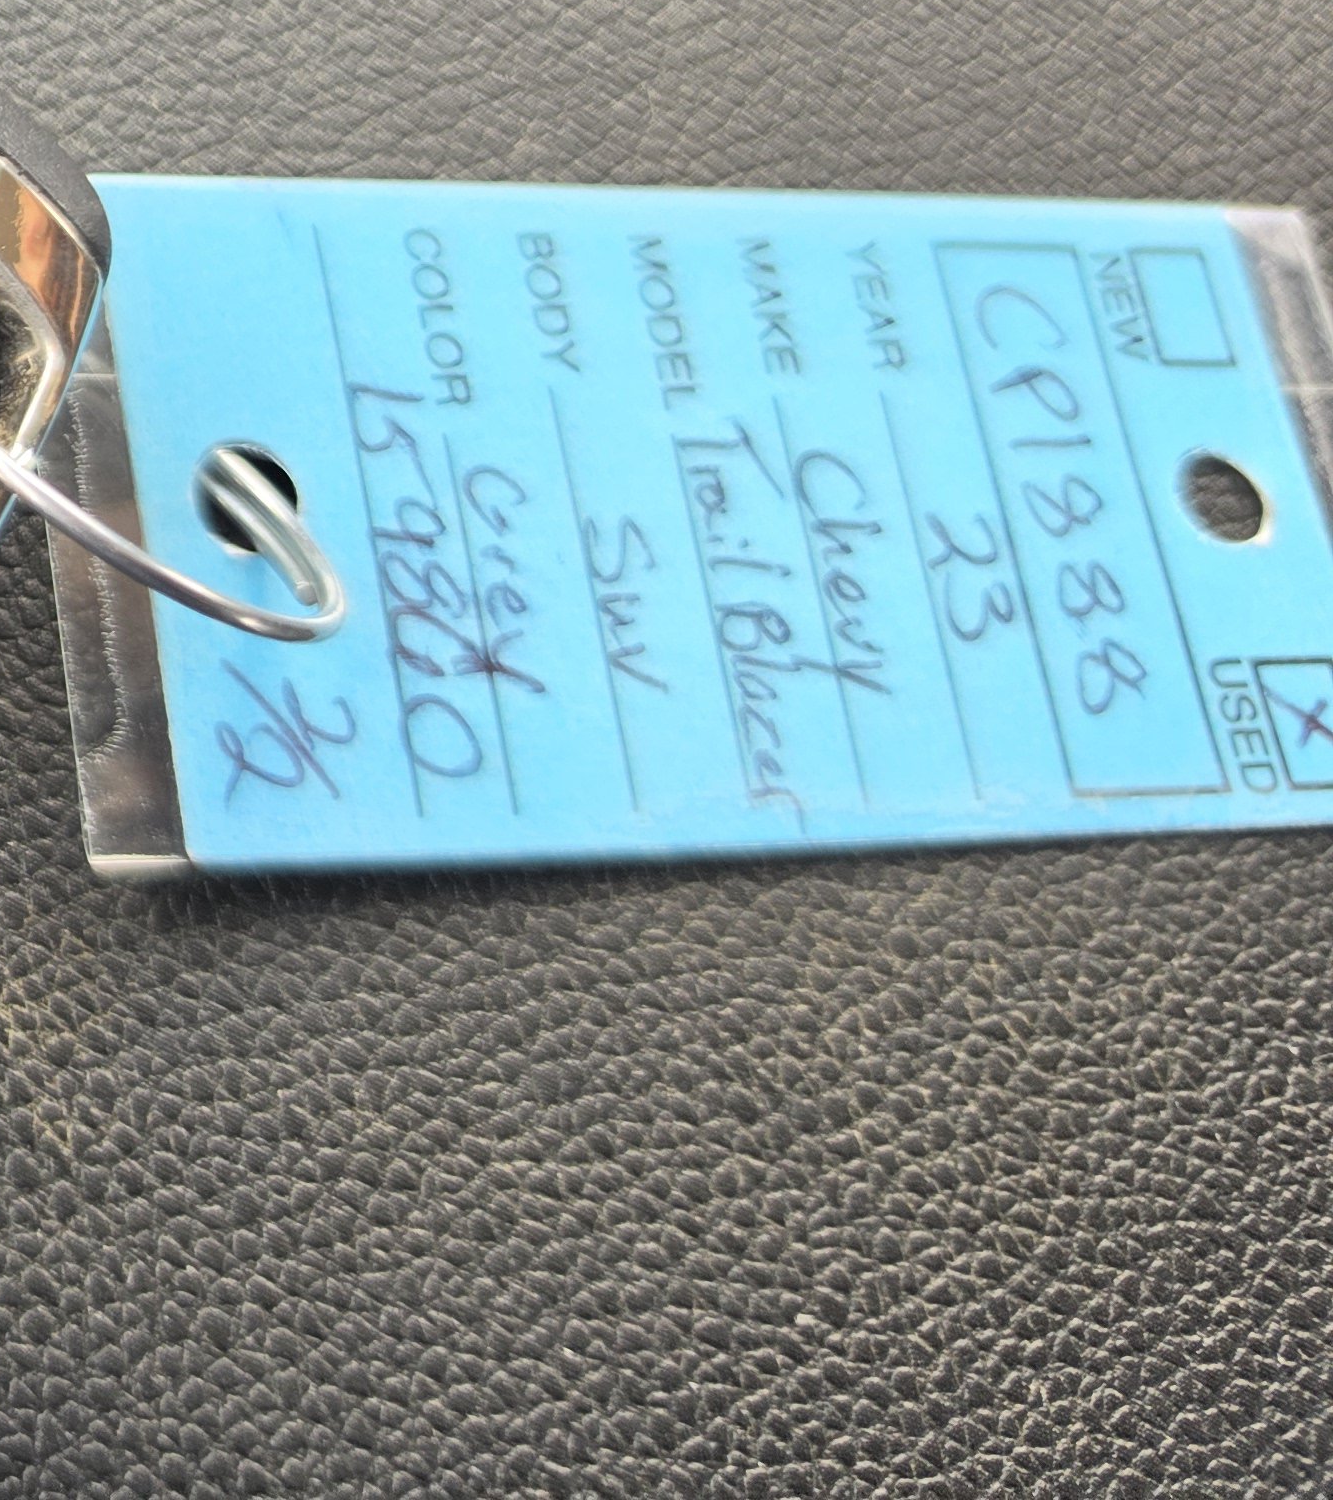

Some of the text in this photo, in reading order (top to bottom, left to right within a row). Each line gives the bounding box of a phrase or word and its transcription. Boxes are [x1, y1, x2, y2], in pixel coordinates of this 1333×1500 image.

[403, 227, 472, 408] COLOR
[517, 230, 581, 375] BODY
[629, 234, 701, 410] MODEL
[738, 235, 803, 378] MAKE
[845, 240, 908, 375] YEAR
[1089, 251, 1149, 362] NEW
[453, 463, 546, 695] Grey
[789, 448, 892, 699] Chevy
[925, 511, 1013, 643] 23
[974, 284, 1147, 717] CP1888
[673, 416, 809, 836] Trail Blazer
[1208, 657, 1279, 794] USED
